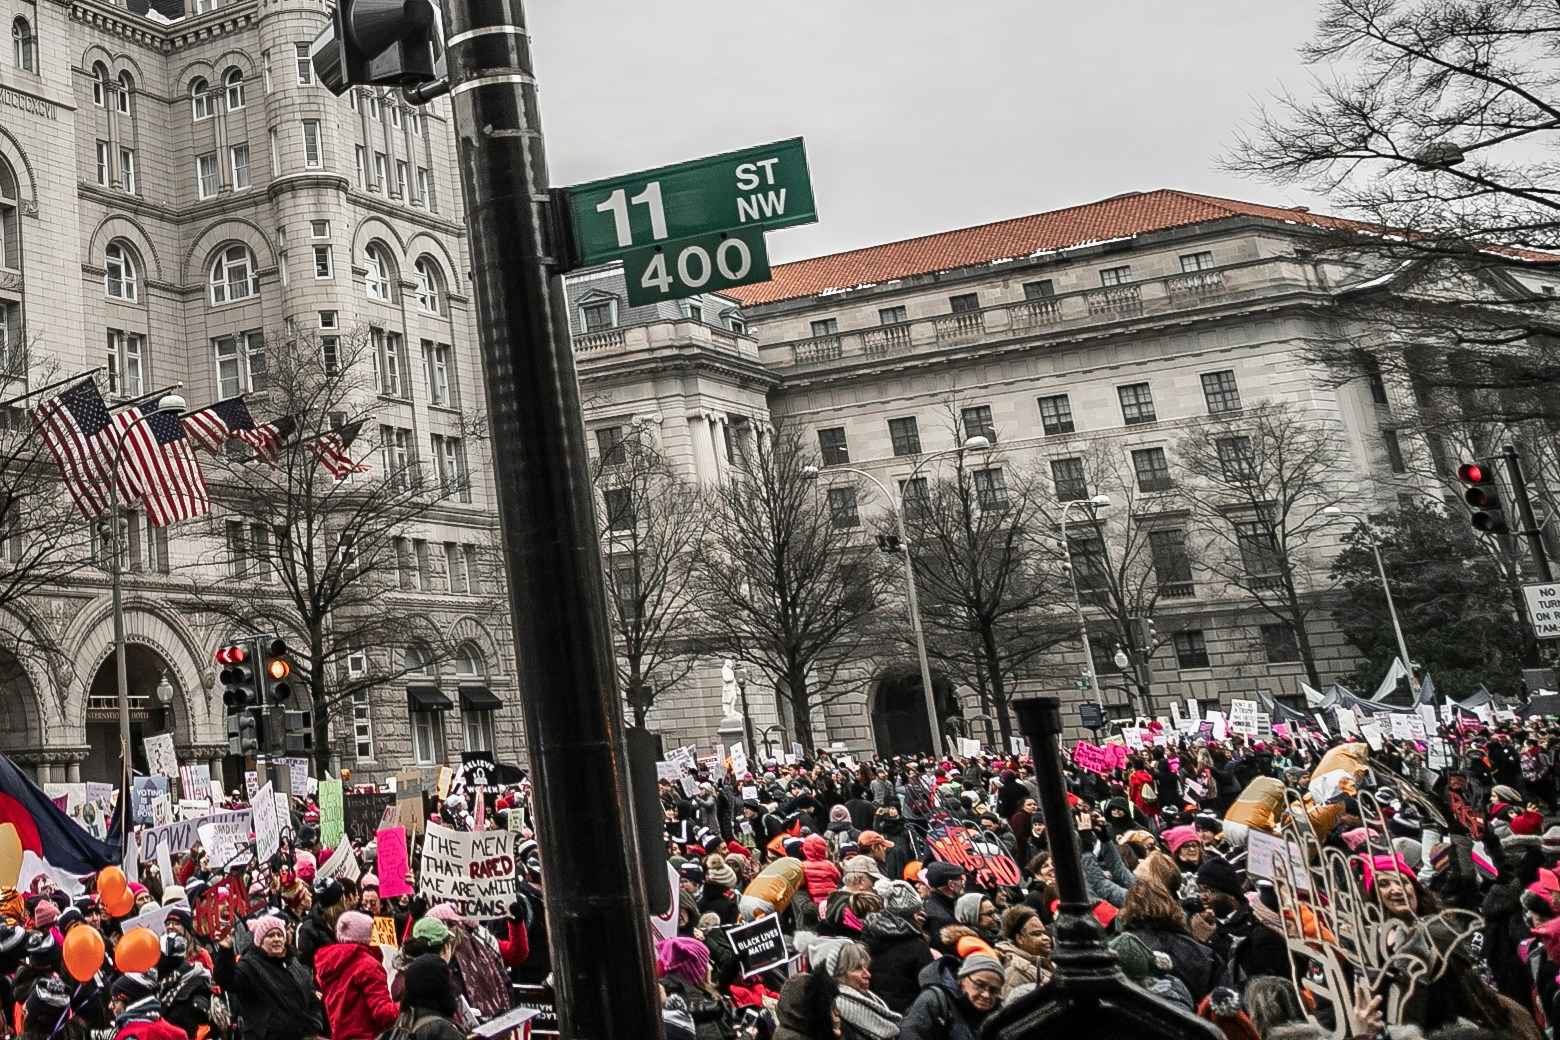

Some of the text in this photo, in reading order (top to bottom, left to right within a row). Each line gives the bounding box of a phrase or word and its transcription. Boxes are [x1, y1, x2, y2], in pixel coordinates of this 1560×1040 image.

[735, 157, 779, 191] ST
[596, 181, 668, 247] 11
[736, 188, 787, 222] NW
[641, 238, 751, 293] 400
[1539, 587, 1556, 597] NO
[1536, 611, 1551, 621] ON
[464, 759, 495, 772] BELIEVE
[136, 788, 164, 797] VOTING
[137, 810, 153, 818] POW
[428, 832, 462, 859] THE
[471, 835, 508, 859] MEN
[423, 854, 463, 878] THAT
[469, 854, 514, 880] RAPED
[421, 875, 445, 894] ME
[451, 880, 476, 898] ARE
[737, 928, 779, 951] BLACK LIVES
[748, 939, 775, 956] MATTER
